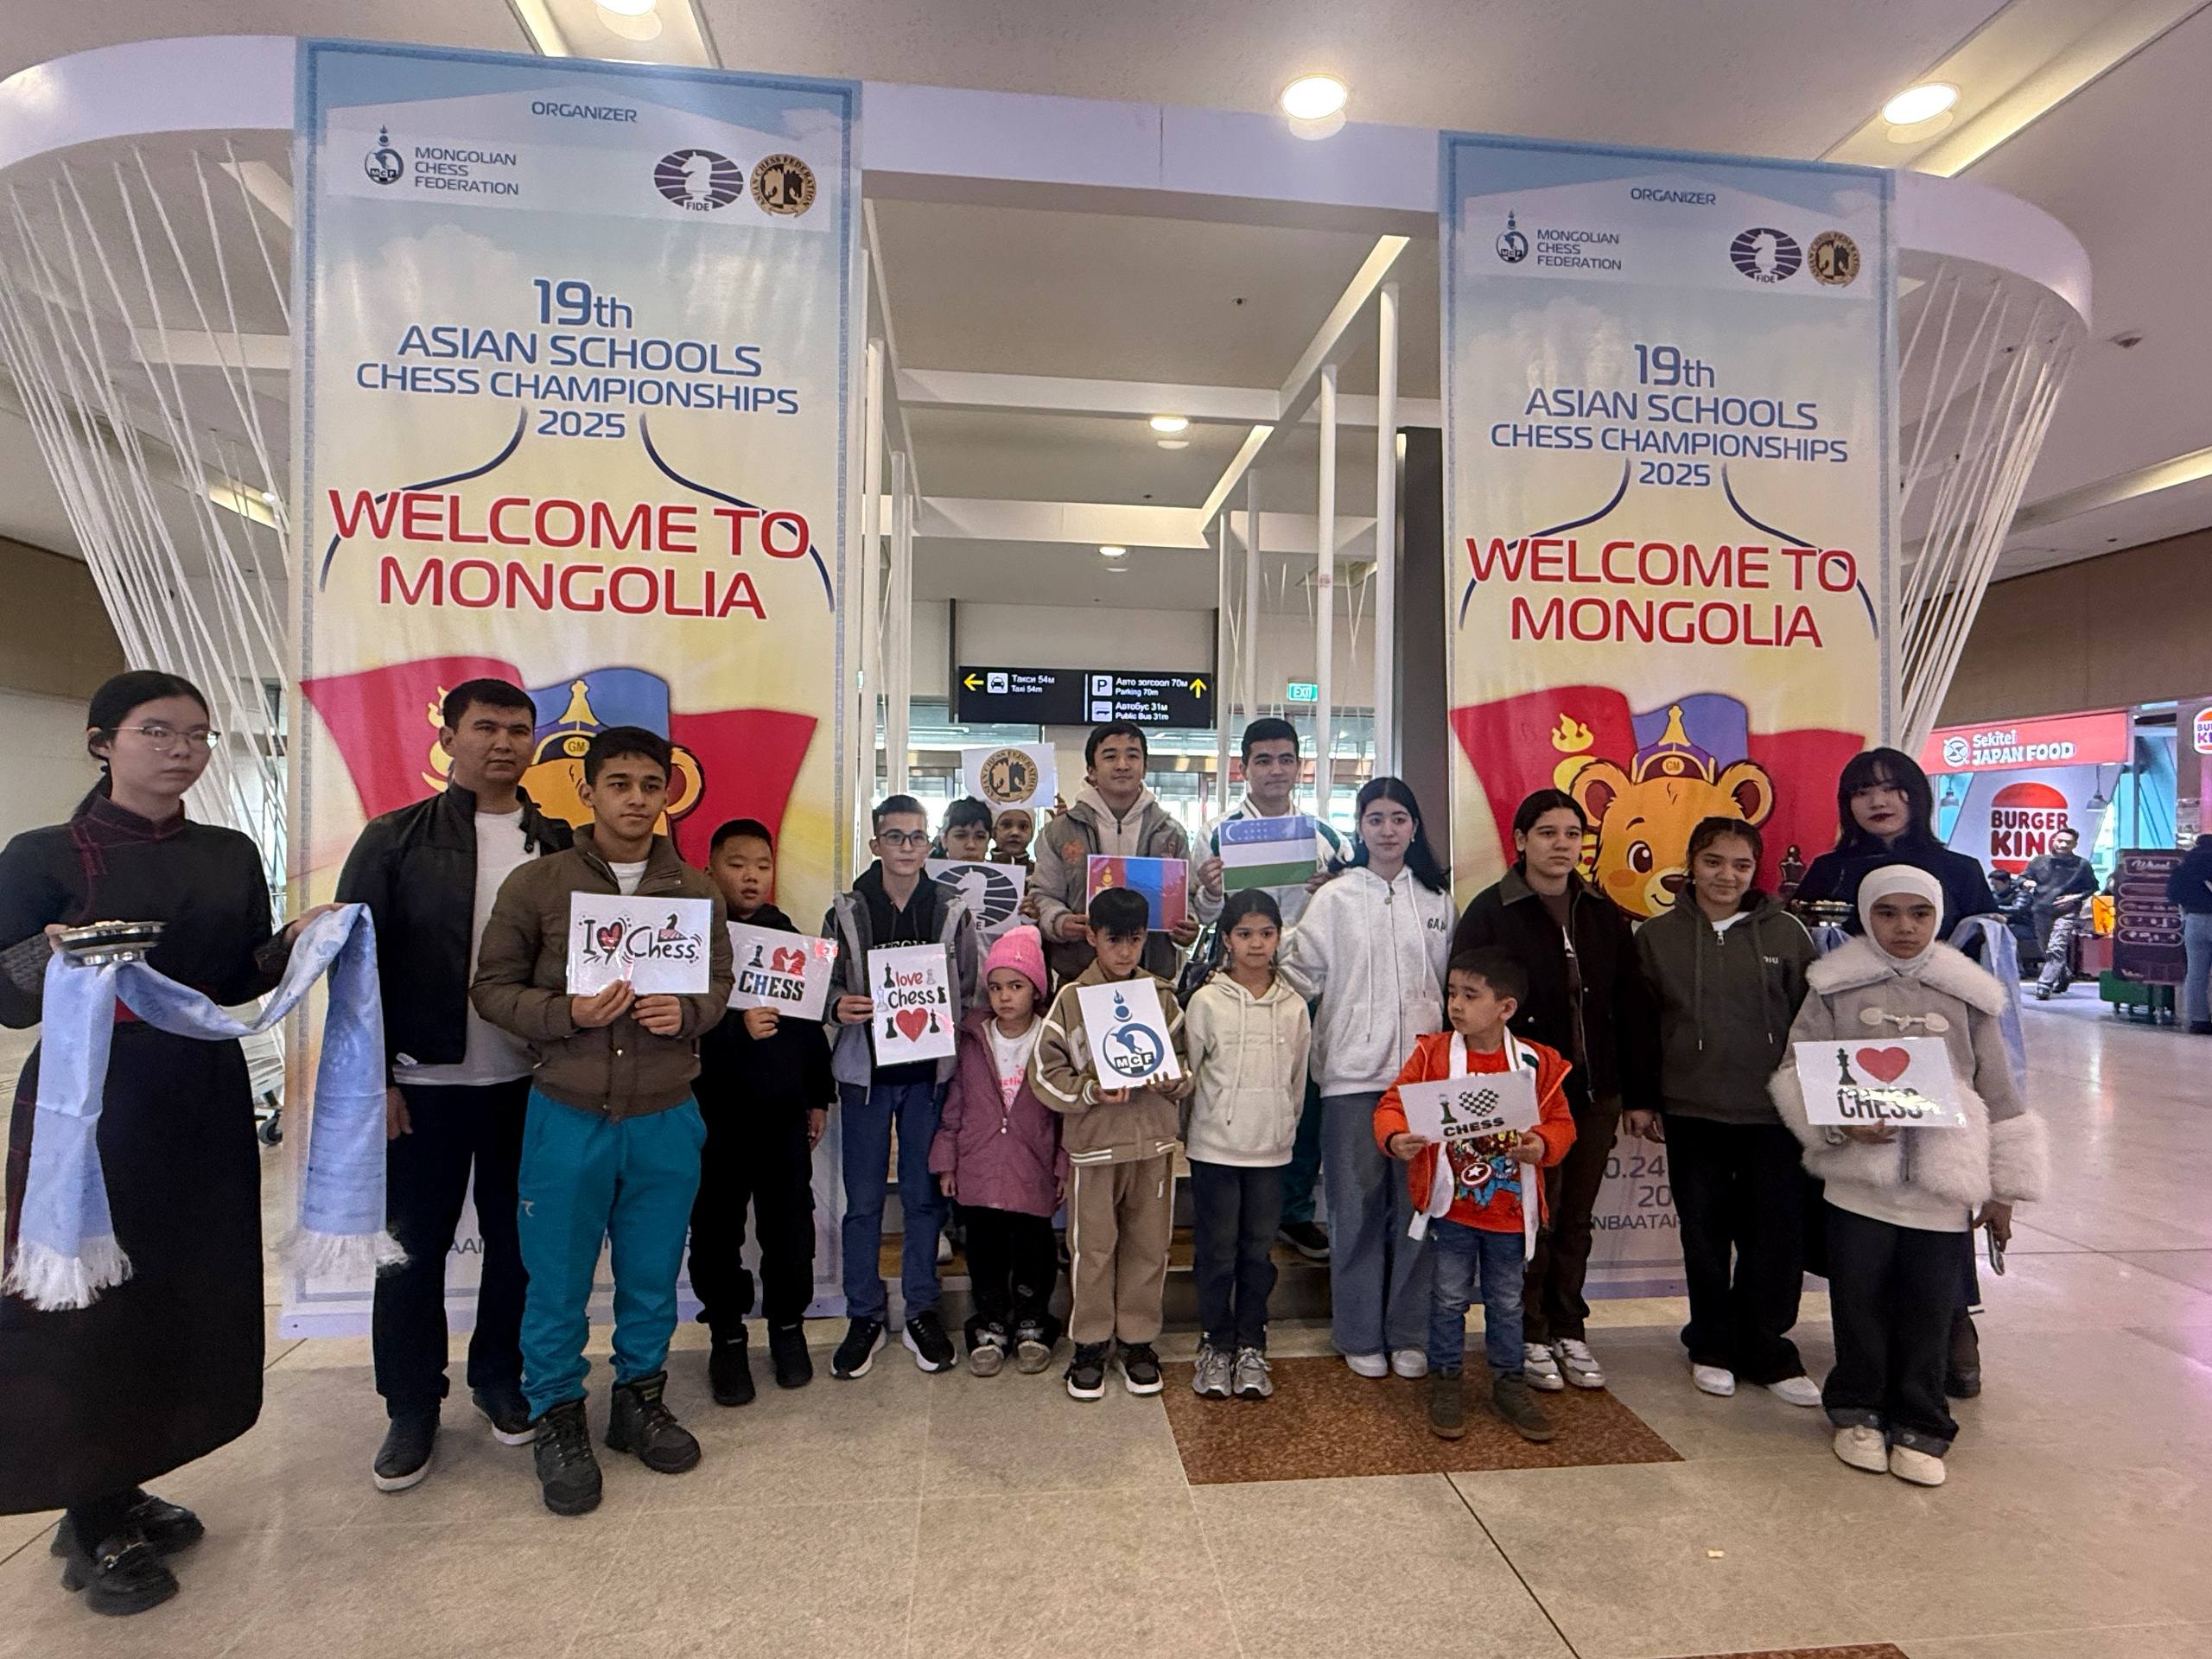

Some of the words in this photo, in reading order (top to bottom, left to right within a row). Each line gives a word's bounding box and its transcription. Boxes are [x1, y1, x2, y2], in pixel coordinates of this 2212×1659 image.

[531, 101, 637, 123] ORGANIZER
[415, 147, 517, 166] MONGOLIAN
[415, 162, 469, 177] CHESS
[415, 176, 519, 195] FEDERATION
[685, 200, 711, 212] FIDE
[1630, 188, 1716, 206] ORGANIZER
[1537, 229, 1619, 244] MONGOLIAN
[1537, 243, 1581, 255] CHESS
[1537, 255, 1622, 270] FEDERATION
[1756, 275, 1776, 283] FIDE
[532, 278, 632, 329] 19th
[397, 325, 537, 364] ASIAN
[550, 335, 762, 378] SCHOOLS
[1634, 344, 1715, 388] 19th
[357, 363, 480, 395] CHESS
[490, 372, 799, 415] CHAMPIONSHIPS
[1525, 388, 1637, 420] ASIAN
[1648, 394, 1818, 429] SCHOOLS
[537, 410, 626, 439] 2025
[1491, 423, 1593, 449] CHESS
[1601, 427, 1847, 462] CHAMPIONSHIPS
[1639, 462, 1711, 486] 2025
[328, 489, 698, 554] WELCOME
[714, 508, 810, 559] TO
[1466, 537, 1770, 588] WELCOME
[1781, 549, 1857, 592] TO
[380, 556, 767, 620] MONGOLIA
[1511, 596, 1823, 648] MONGOLIA
[1116, 677, 1136, 686] Авто
[1116, 688, 1141, 697] Parking
[1294, 686, 1312, 698] EXIT
[1116, 702, 1149, 711] Автобус
[568, 741, 586, 752] GM
[1973, 729, 2017, 747] Sekitei
[1973, 747, 2024, 766] JAPAN
[2026, 742, 2074, 761] FOOD
[1992, 810, 2069, 830] BURGER
[1992, 830, 2055, 857] KIN
[626, 926, 696, 958] Chess
[739, 970, 805, 1001] CHESS
[895, 971, 924, 987] love
[888, 988, 936, 1009] Chess
[1116, 1053, 1153, 1068] MCF
[1444, 1117, 1504, 1136] CHESS
[1591, 1213, 1681, 1230] NBAATA
